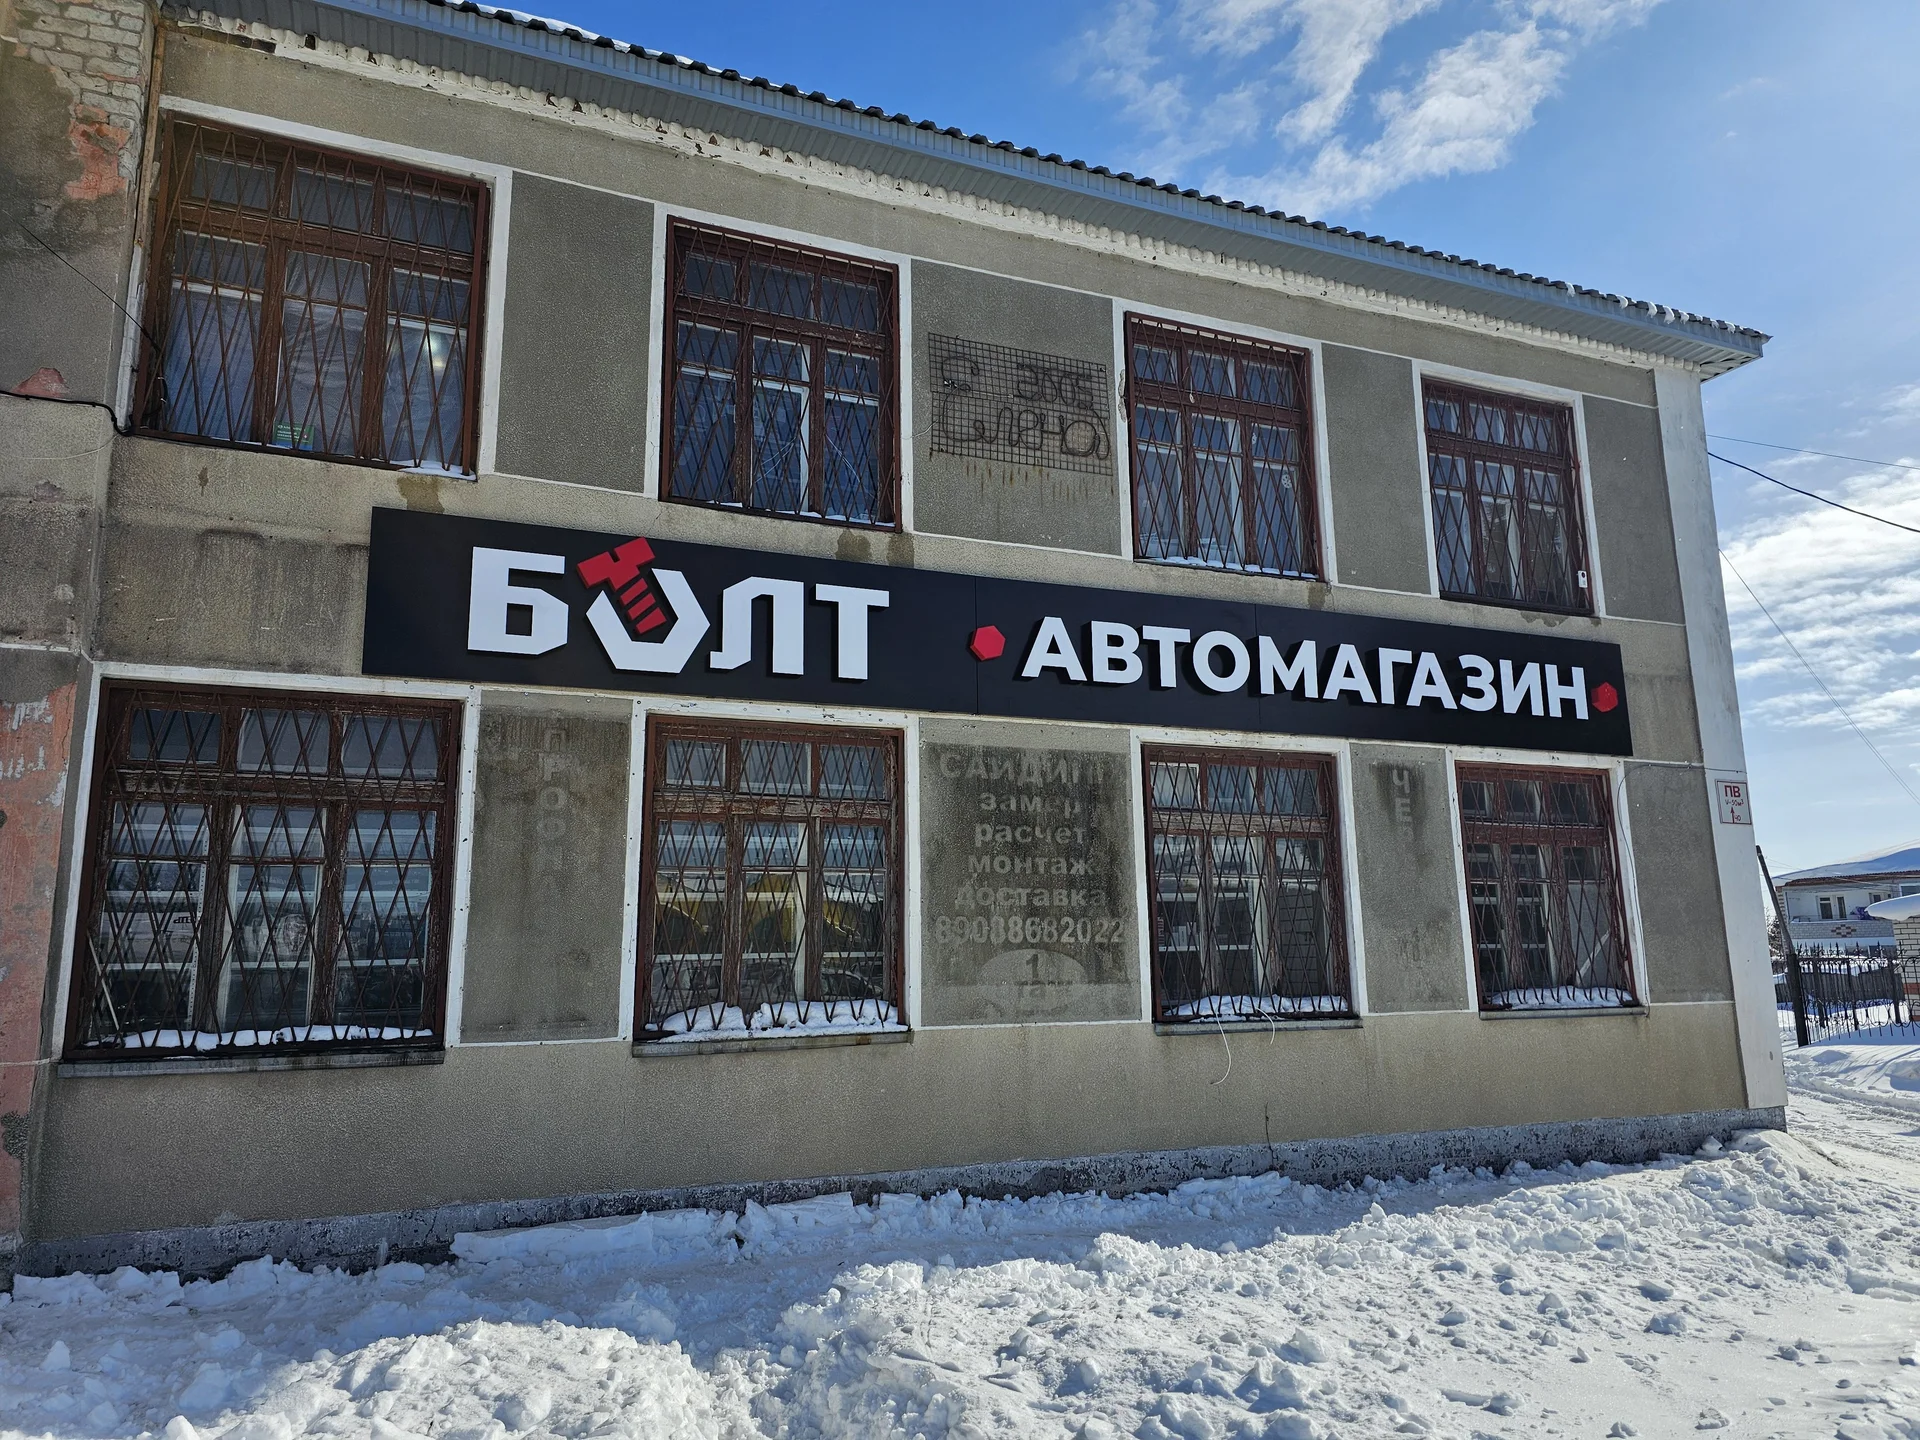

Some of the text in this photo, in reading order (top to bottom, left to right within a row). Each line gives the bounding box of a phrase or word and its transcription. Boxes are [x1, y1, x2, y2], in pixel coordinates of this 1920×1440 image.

[467, 538, 890, 681] БОЛТ
[1021, 617, 1591, 721] АВТОМАГАЗИН
[1724, 785, 1741, 798] ПВ
[975, 822, 1087, 848] расчет
[968, 855, 1097, 876] монтаж
[954, 884, 1107, 909] доставка
